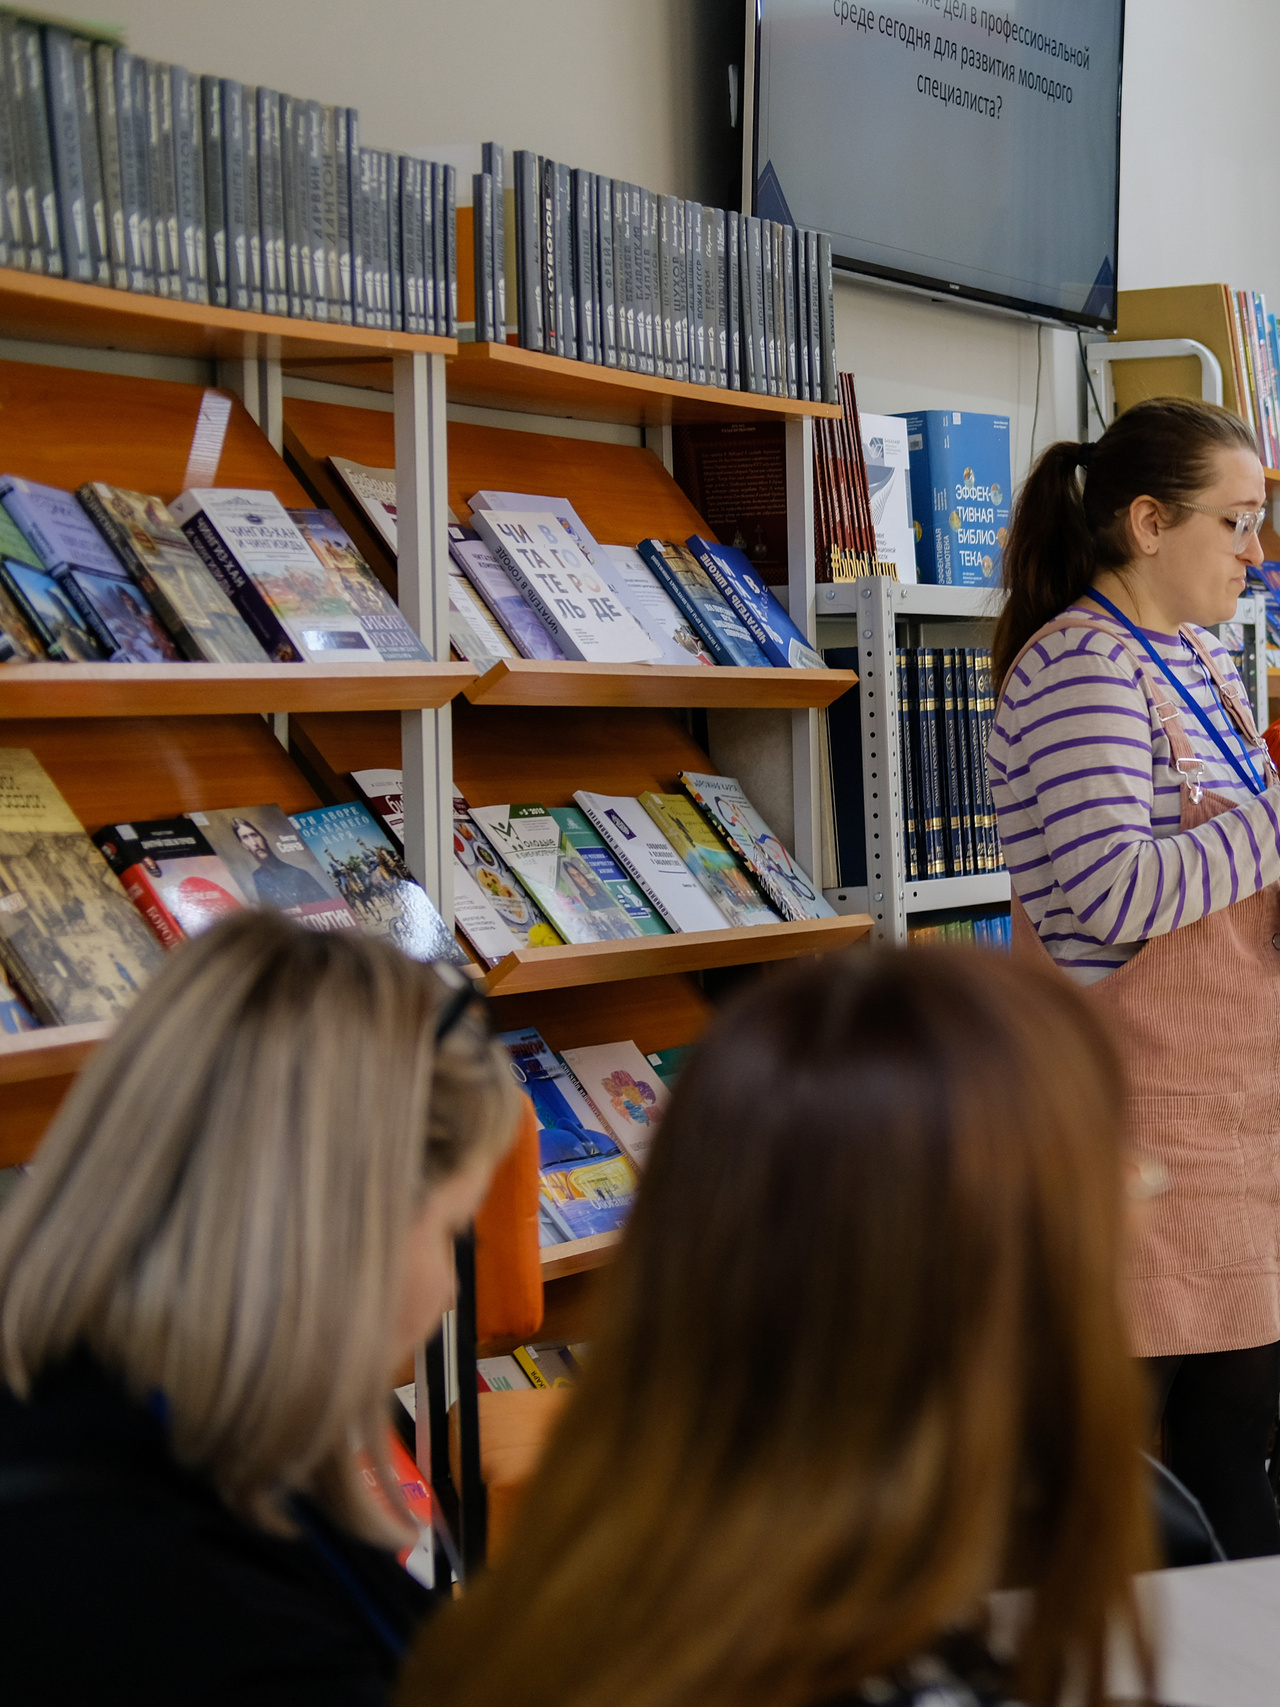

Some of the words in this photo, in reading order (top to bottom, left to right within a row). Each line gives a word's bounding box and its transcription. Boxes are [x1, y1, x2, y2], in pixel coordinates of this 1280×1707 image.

[833, 0, 875, 34] среде
[878, 14, 932, 52] сегодня
[933, 35, 958, 62] для
[960, 44, 1016, 83] развития
[1018, 67, 1074, 104] молодого
[943, 0, 968, 20] дел
[970, 8, 978, 25] в
[980, 10, 1091, 71] профессиональной
[916, 73, 1003, 120] специалиста?
[546, 198, 554, 292] СУВОРОВ
[603, 236, 612, 289] ФРЕЙД
[624, 245, 634, 302] БЕРДЯЕВ
[633, 226, 643, 300] БЛАВАТСКАЯ
[672, 256, 681, 312] ШУХОВ
[756, 266, 764, 326] ПОТЕМКИН
[696, 284, 704, 320] ВОЖДИ
[954, 484, 991, 502] ЭФФЕК-
[226, 526, 298, 538] ЧИНГИЗ-ХАН
[956, 506, 994, 524] ТИВНАЯ
[496, 523, 534, 544] ЧИ
[537, 524, 558, 544] В
[958, 528, 998, 546] БИБЛИО-
[197, 516, 246, 588] ЧИНГИЗ-ХАН
[494, 545, 522, 582] ГОРОДЕ
[516, 548, 552, 568] ТА
[550, 548, 582, 568] ГО
[935, 528, 944, 584] ЭФФЕКТИВНАЯ
[944, 535, 952, 584] БИБЛИОТЕКА
[958, 550, 983, 566] ТЕКА
[520, 581, 528, 590] В
[534, 573, 569, 594] ТЕ
[566, 573, 601, 594] РО
[700, 552, 728, 588] ШКОЛЕ
[742, 574, 760, 594] В
[724, 587, 733, 596] В
[527, 588, 558, 635] ЧИТАТЕЛЬ
[553, 598, 587, 618] ЛЬ
[587, 597, 622, 622] ДЕ
[732, 594, 767, 644] ЧИТАТЕЛЬ
[301, 815, 370, 838] ОСЛЕДНЕГО
[321, 806, 360, 823] ДВОРЕ
[587, 808, 614, 843] БИБЛИОТЕКЕ
[322, 830, 354, 845] ЦАРЯ
[299, 908, 356, 932] СПУТИН
